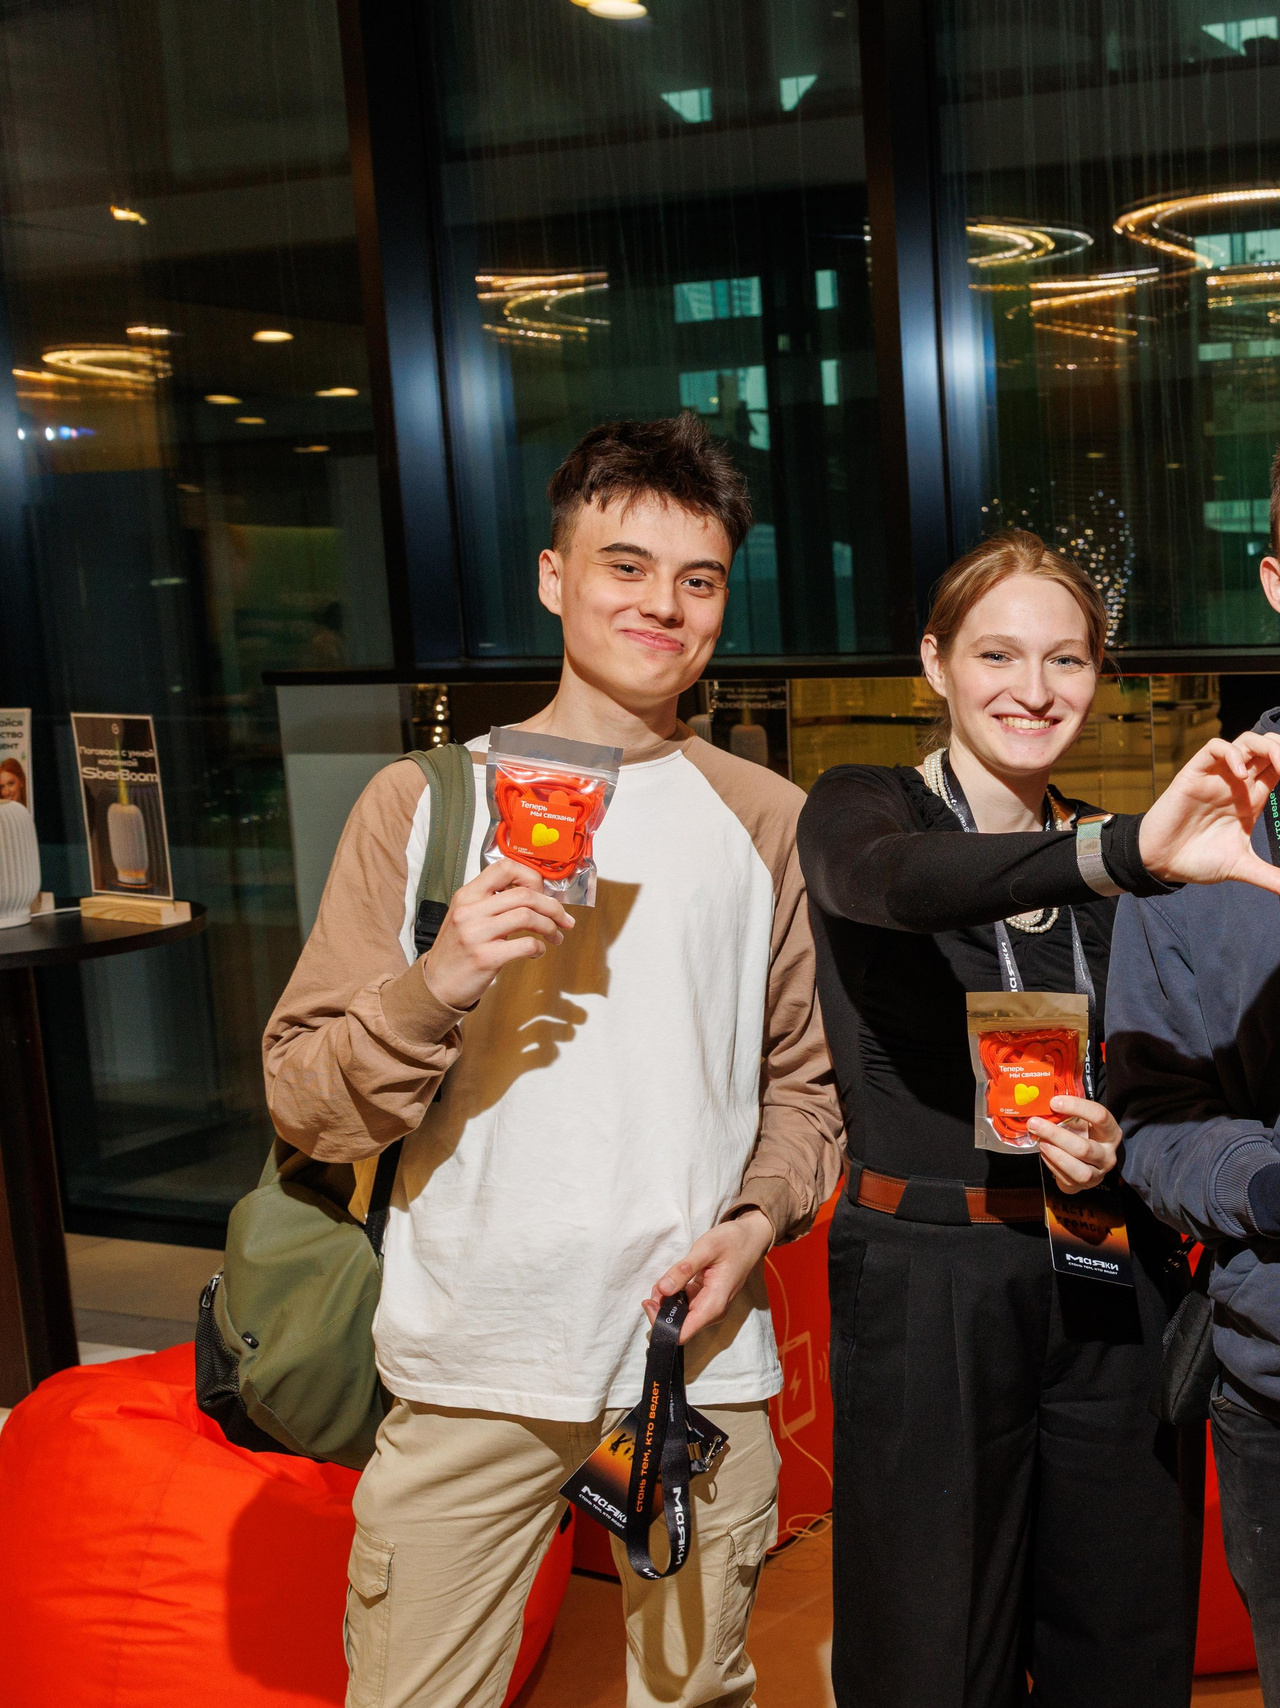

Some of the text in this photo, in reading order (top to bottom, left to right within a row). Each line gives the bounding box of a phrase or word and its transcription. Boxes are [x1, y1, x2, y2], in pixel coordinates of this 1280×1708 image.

[82, 766, 159, 782] SberBoom
[521, 800, 548, 811] Теперь
[1269, 788, 1279, 818] веде
[543, 813, 575, 822] связаны
[999, 1065, 1024, 1073] Теперь
[635, 1381, 660, 1513] стань тем, кто ведет
